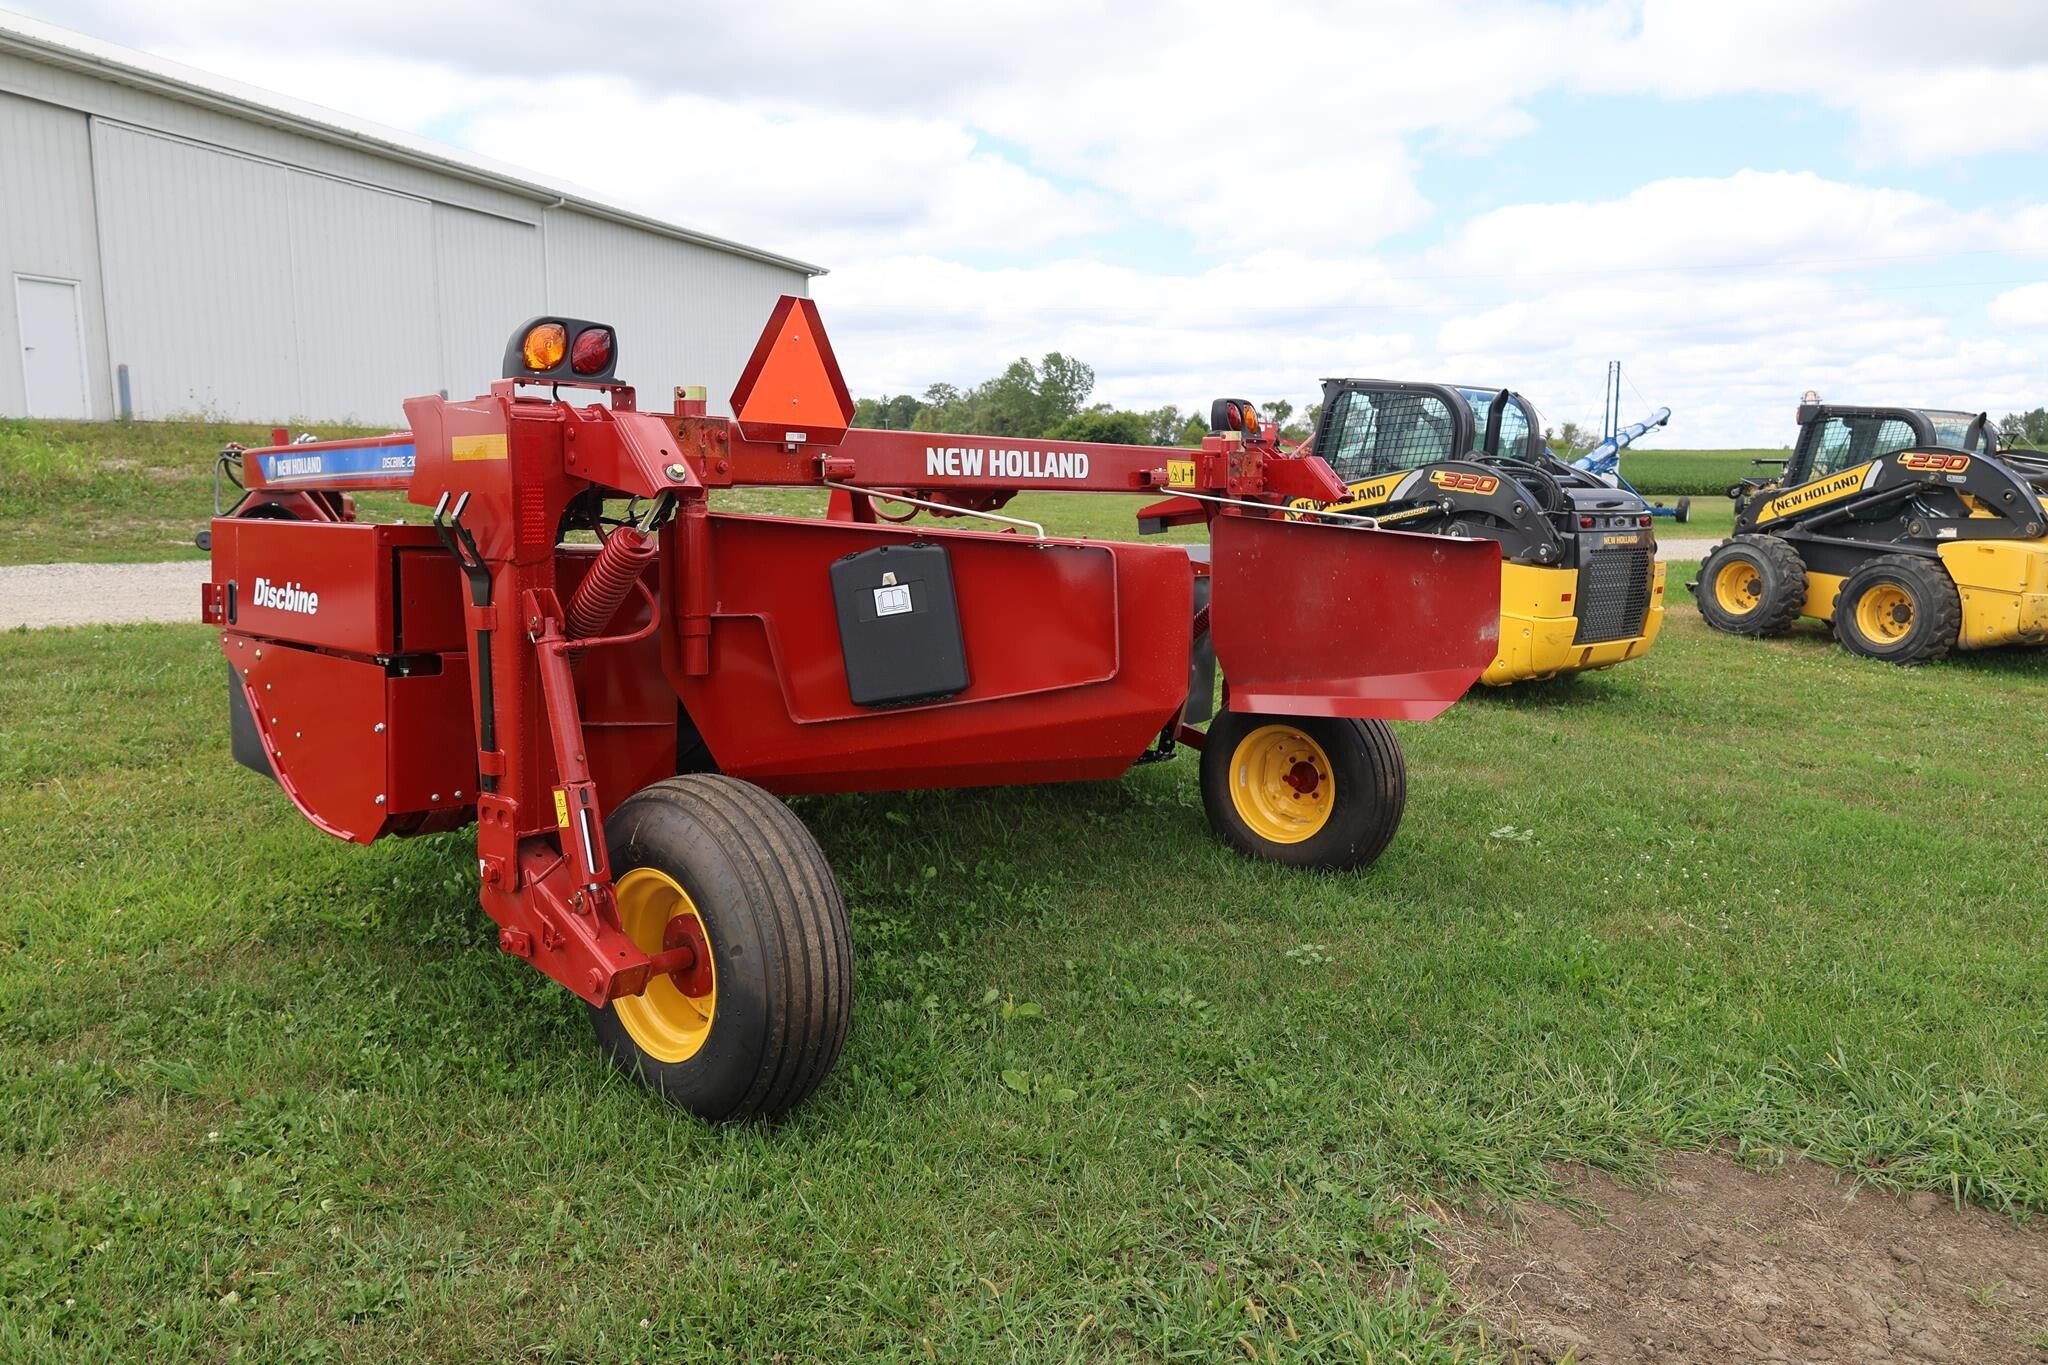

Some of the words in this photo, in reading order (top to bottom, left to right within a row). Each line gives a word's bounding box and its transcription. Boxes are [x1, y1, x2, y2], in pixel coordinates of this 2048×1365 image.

[277, 458, 292, 476] NEW
[292, 456, 322, 474] HOLLAND
[926, 447, 983, 476] NEW
[989, 449, 1089, 479] HOLLAND
[1776, 494, 1802, 511] NEW
[1804, 474, 1859, 501] HOLLAND
[1603, 536, 1616, 544] NEW
[1616, 535, 1638, 544] HOLLAND
[253, 577, 318, 615] Discbine
